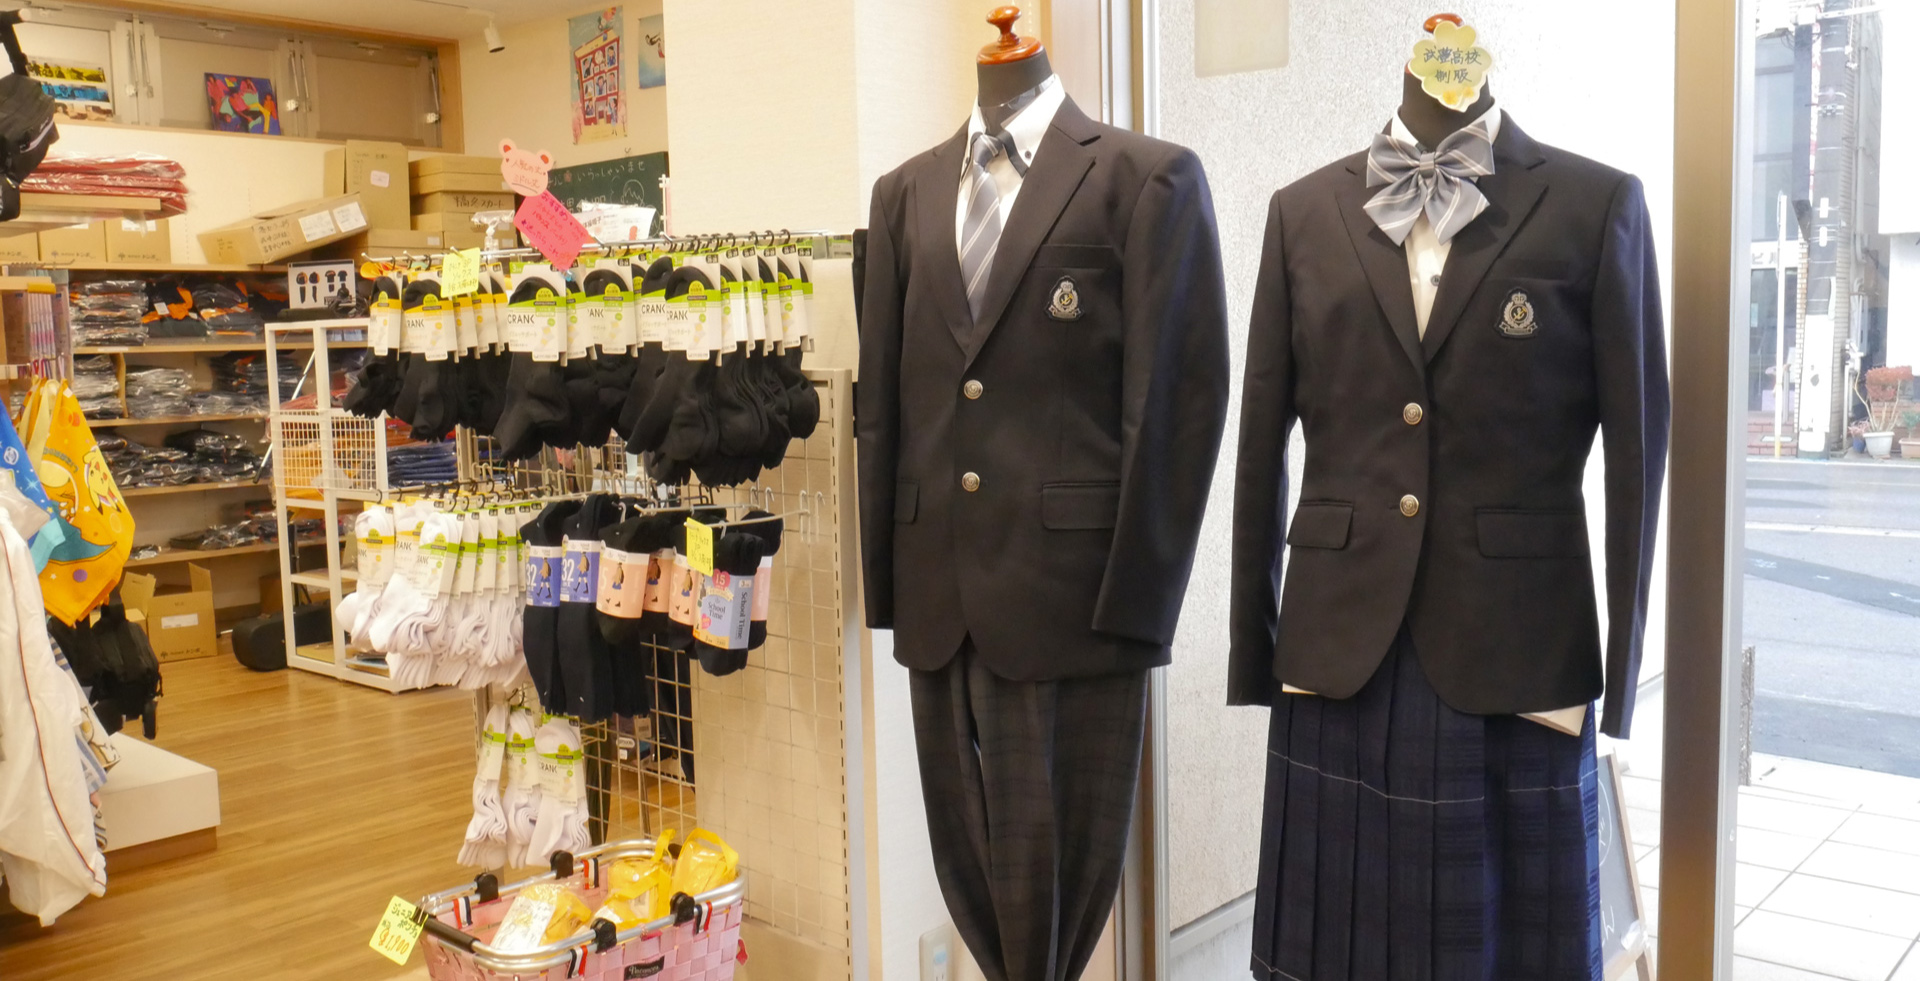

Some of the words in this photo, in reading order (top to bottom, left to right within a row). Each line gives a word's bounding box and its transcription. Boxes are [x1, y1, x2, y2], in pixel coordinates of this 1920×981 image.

[1434, 68, 1472, 84] 制服
[577, 160, 646, 182] いらっしゃいませ
[526, 563, 537, 587] 32
[562, 558, 575, 582] 32
[715, 574, 726, 585] 15
[708, 601, 726, 614] School
[708, 609, 724, 620] Time
[740, 592, 748, 617] School
[736, 619, 746, 639] Time
